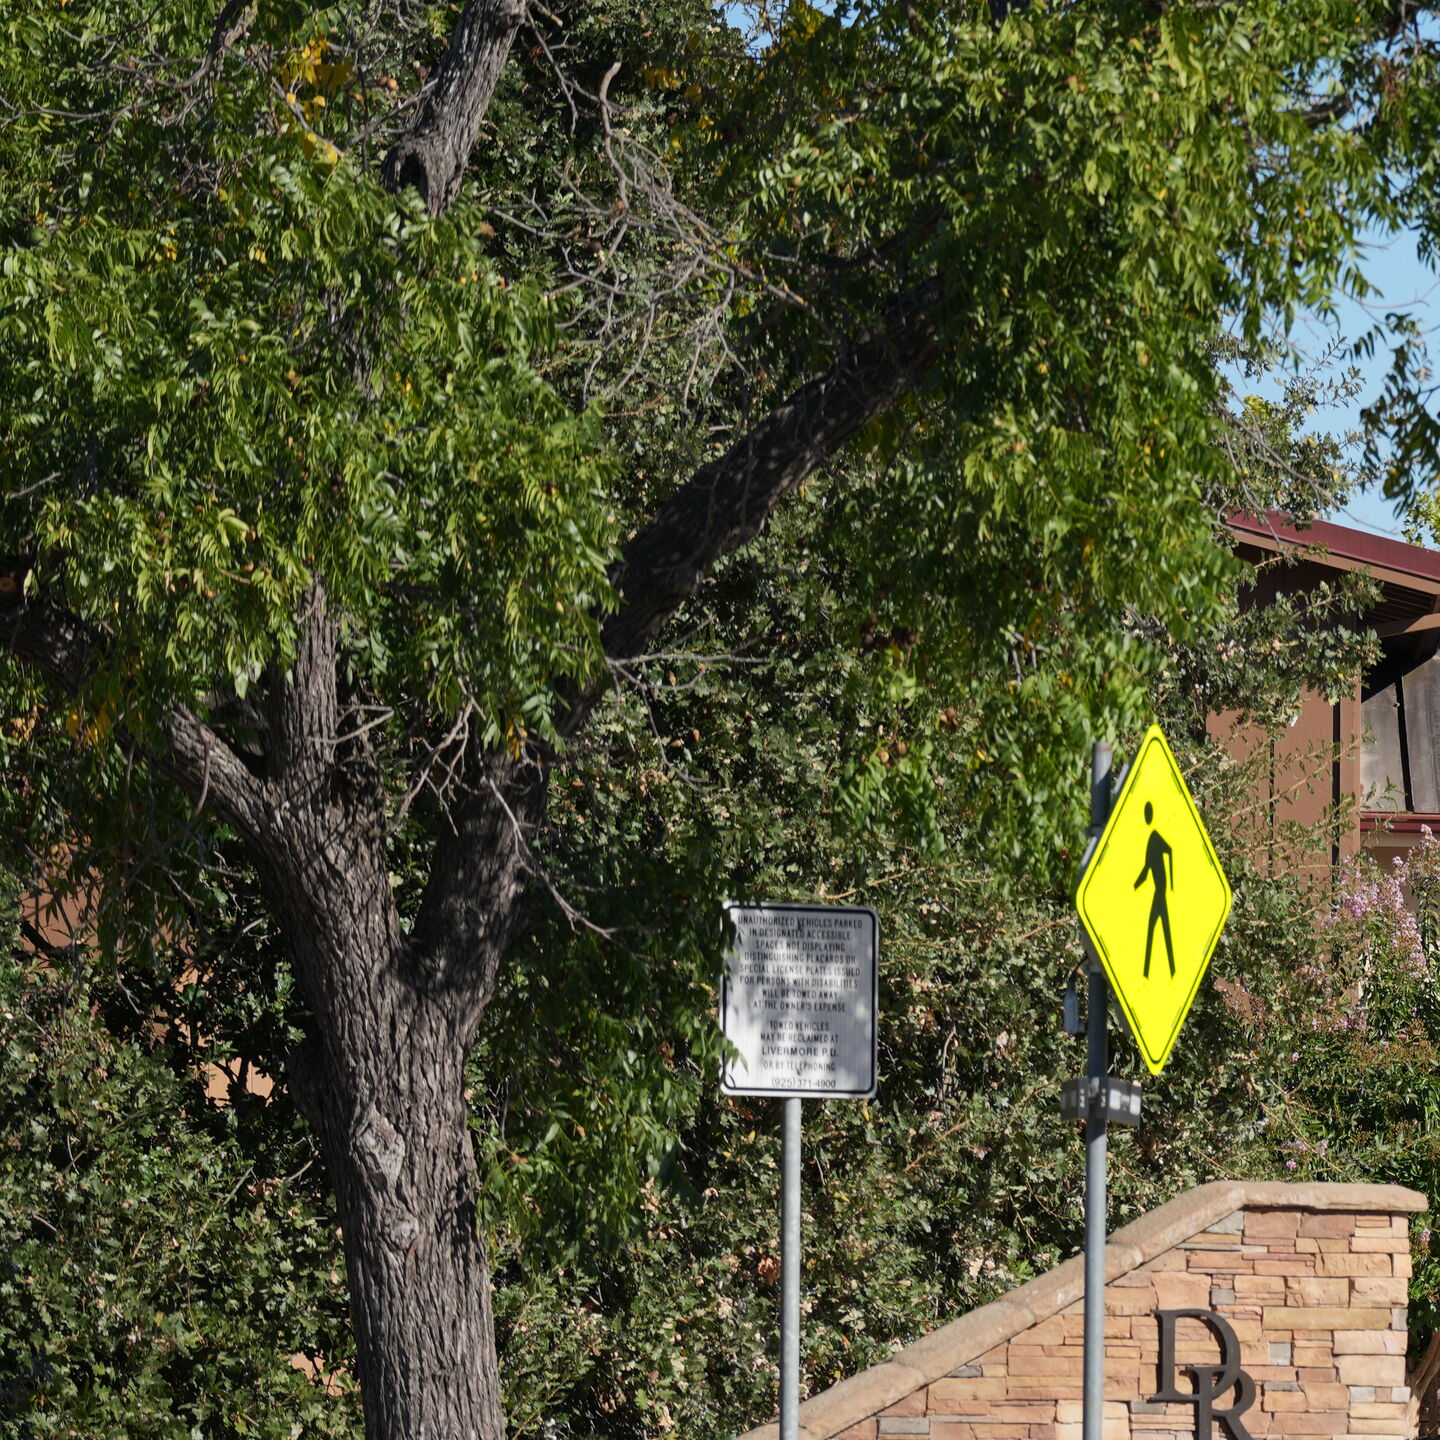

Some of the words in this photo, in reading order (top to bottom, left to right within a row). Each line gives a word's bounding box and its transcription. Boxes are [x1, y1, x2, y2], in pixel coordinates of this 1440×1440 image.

[738, 916, 795, 926] UNAUTHORIZED
[797, 917, 833, 927] VEHICLES
[834, 919, 863, 929] PARKED
[750, 928, 757, 937] IN
[759, 928, 805, 938] DESIGNATED
[807, 930, 851, 940] ACCESSIBLE
[755, 941, 784, 950] SPACES
[786, 942, 800, 951] NOT
[802, 942, 846, 952] DISPLAYING
[744, 952, 804, 962] DISTINGUISHING
[806, 954, 844, 963] PLACARDS
[846, 955, 856, 964] OR
[739, 964, 769, 974] SPECIAL
[772, 965, 803, 975] LICENSE
[805, 966, 832, 976] PLATES
[834, 967, 860, 977] ISSUED
[740, 976, 754, 984] FOR
[757, 976, 791, 986] PERSONS
[793, 978, 811, 987] WITH
[812, 978, 858, 989] DISABILITIES
[762, 989, 778, 998] WILL
[781, 989, 789, 999] BE
[792, 990, 817, 999] TOWED
[819, 991, 838, 1000] AWAY
[753, 1001, 762, 1009] AT
[764, 1001, 777, 1010] THE
[780, 1002, 812, 1011] OWNER'S
[814, 1003, 846, 1012] EXPENSE
[770, 1020, 794, 1030] TOWED
[795, 1021, 830, 1031] VEHICLES
[760, 1033, 774, 1042] MAY
[777, 1033, 785, 1041] BE
[788, 1033, 829, 1043] RECLAIMED
[830, 1034, 839, 1043] AT
[761, 1046, 818, 1056] LIVERMORE
[763, 1060, 773, 1069] OR
[775, 1061, 784, 1069] BY
[787, 1061, 836, 1072] TELEPHONING
